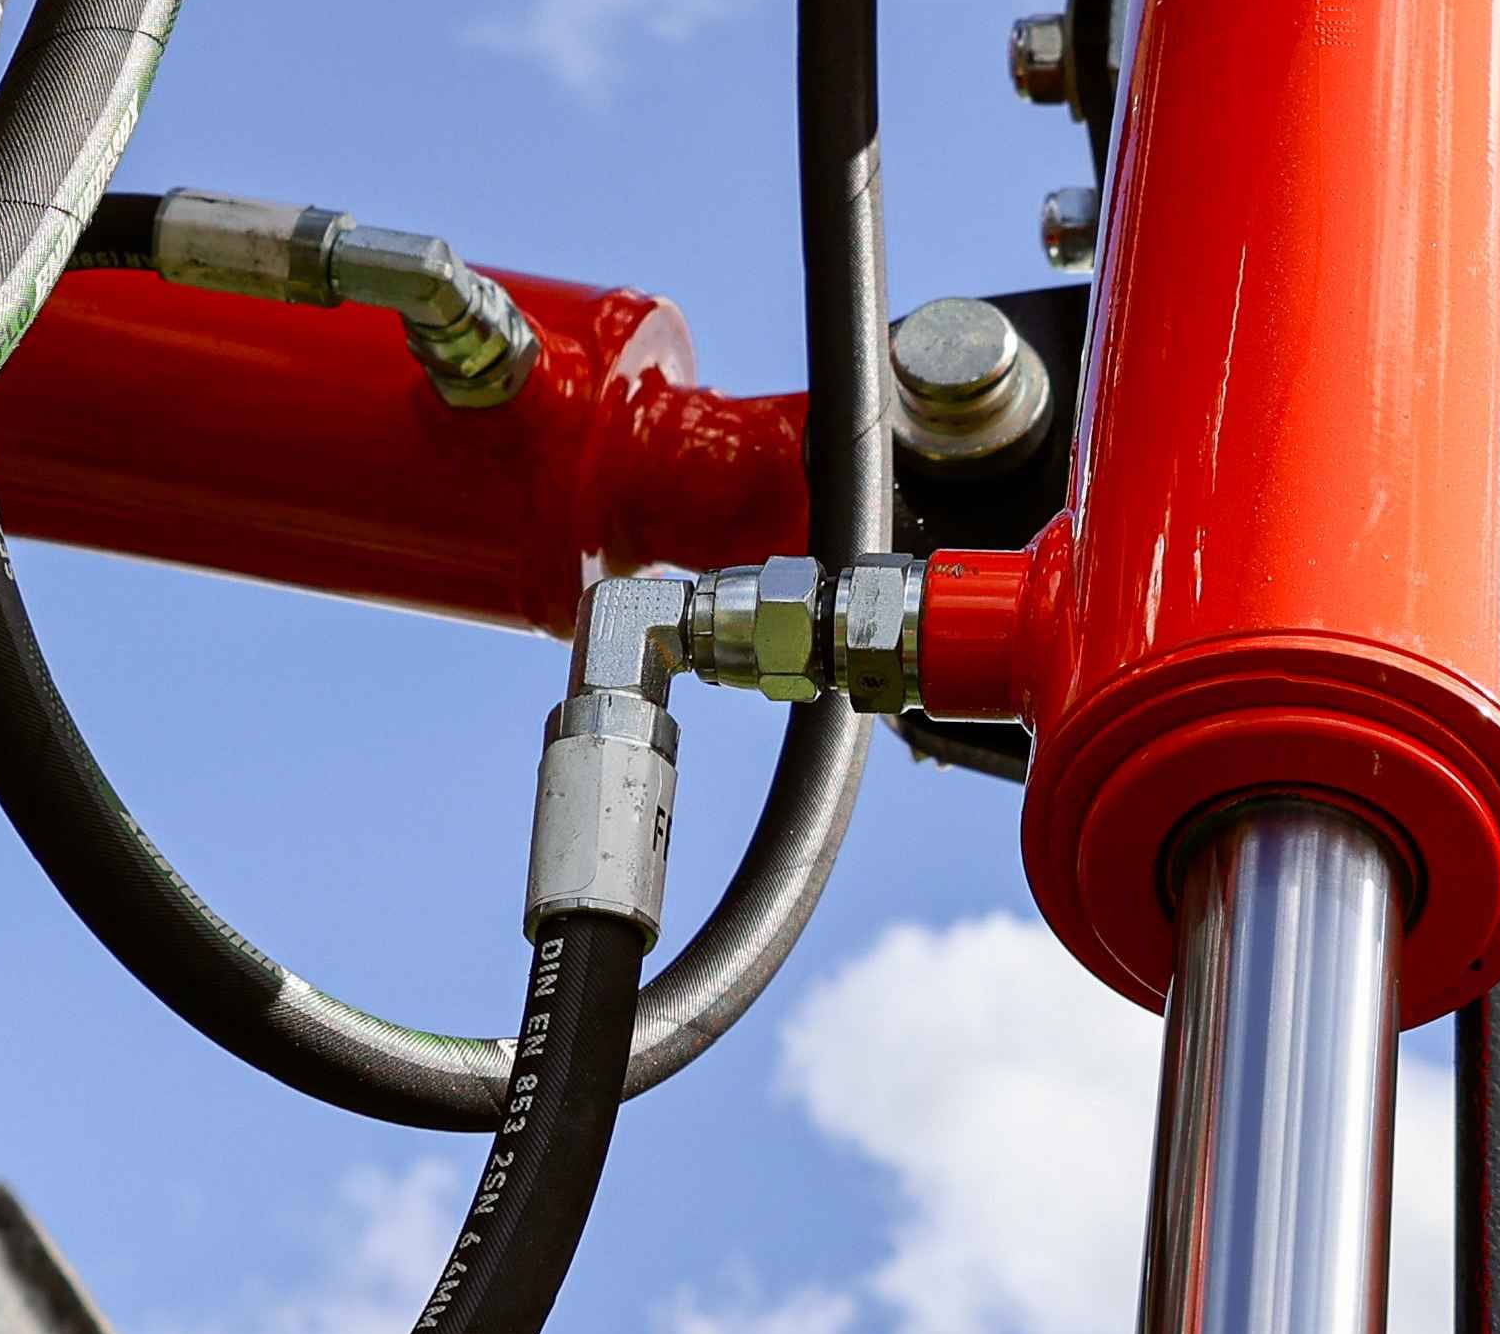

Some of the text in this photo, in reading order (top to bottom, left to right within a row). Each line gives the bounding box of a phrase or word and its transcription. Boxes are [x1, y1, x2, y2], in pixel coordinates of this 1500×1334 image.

[533, 937, 564, 997] DIN
[521, 1012, 550, 1057] EN
[502, 1073, 538, 1134] 853
[473, 1150, 514, 1215] 2SN
